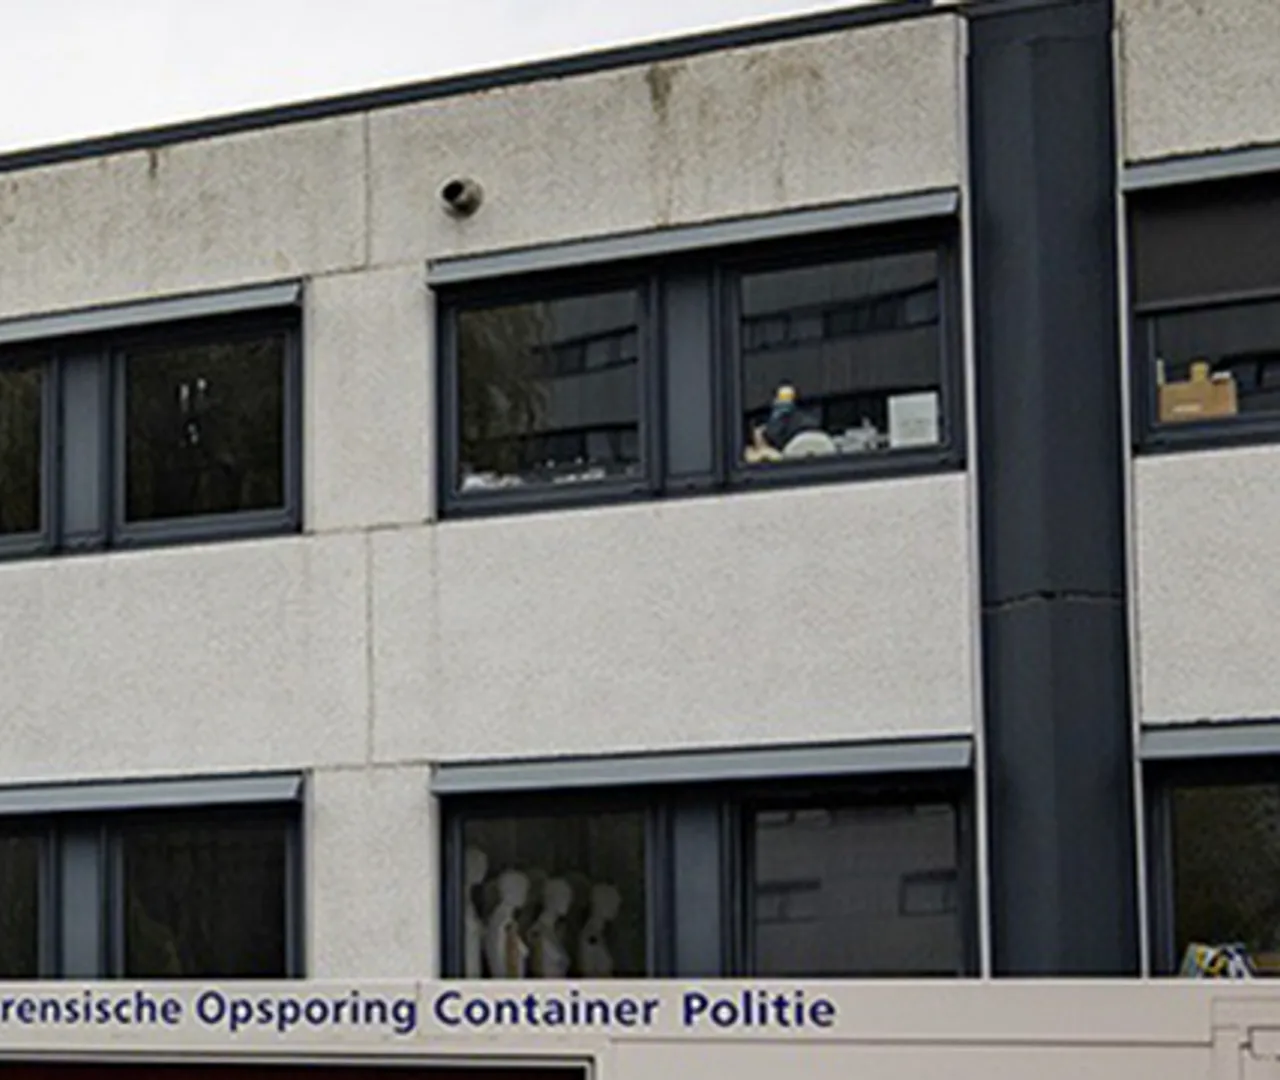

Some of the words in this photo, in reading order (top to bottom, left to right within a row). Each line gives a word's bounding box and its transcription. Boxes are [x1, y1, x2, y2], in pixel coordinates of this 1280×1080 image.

[196, 990, 418, 1034] Opsporing
[434, 989, 660, 1026] Container
[682, 990, 836, 1027] Politie
